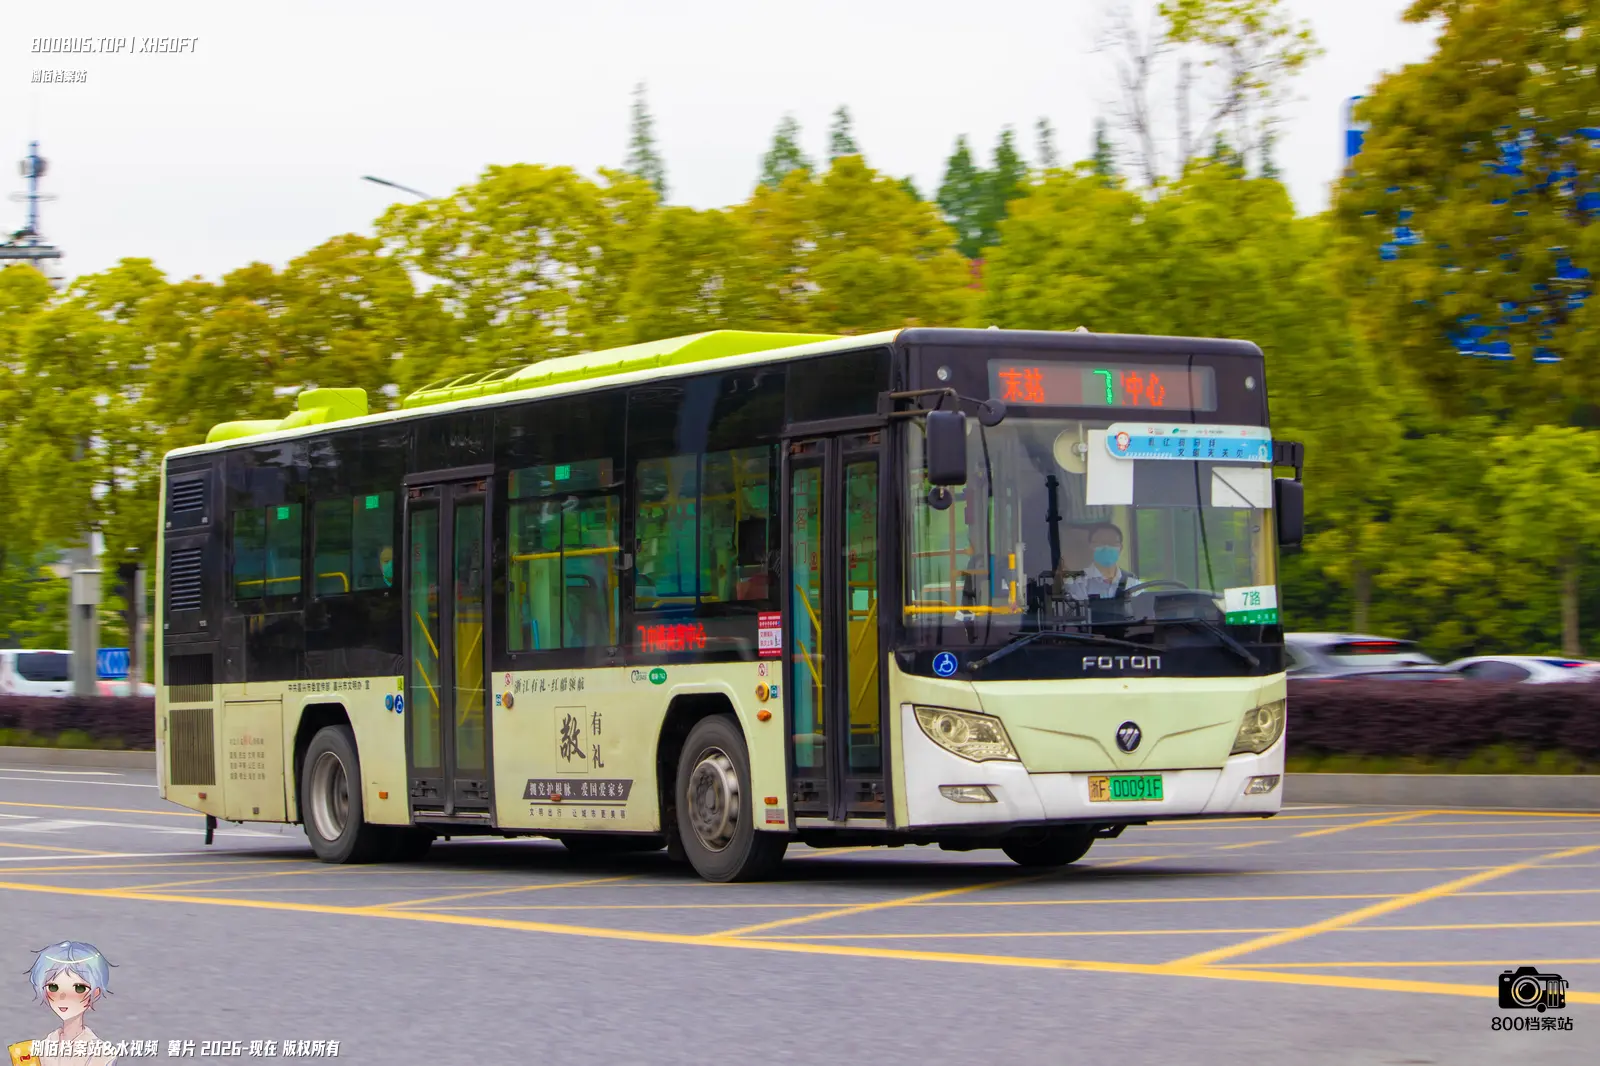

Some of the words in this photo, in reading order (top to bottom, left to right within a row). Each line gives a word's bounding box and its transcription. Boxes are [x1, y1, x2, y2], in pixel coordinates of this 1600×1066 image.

[1093, 370, 1113, 404] 7
[1120, 370, 1166, 407] 中心
[1242, 591, 1261, 606] 7路
[1082, 655, 1161, 670] FOTON
[1113, 778, 1161, 798] 00091F
